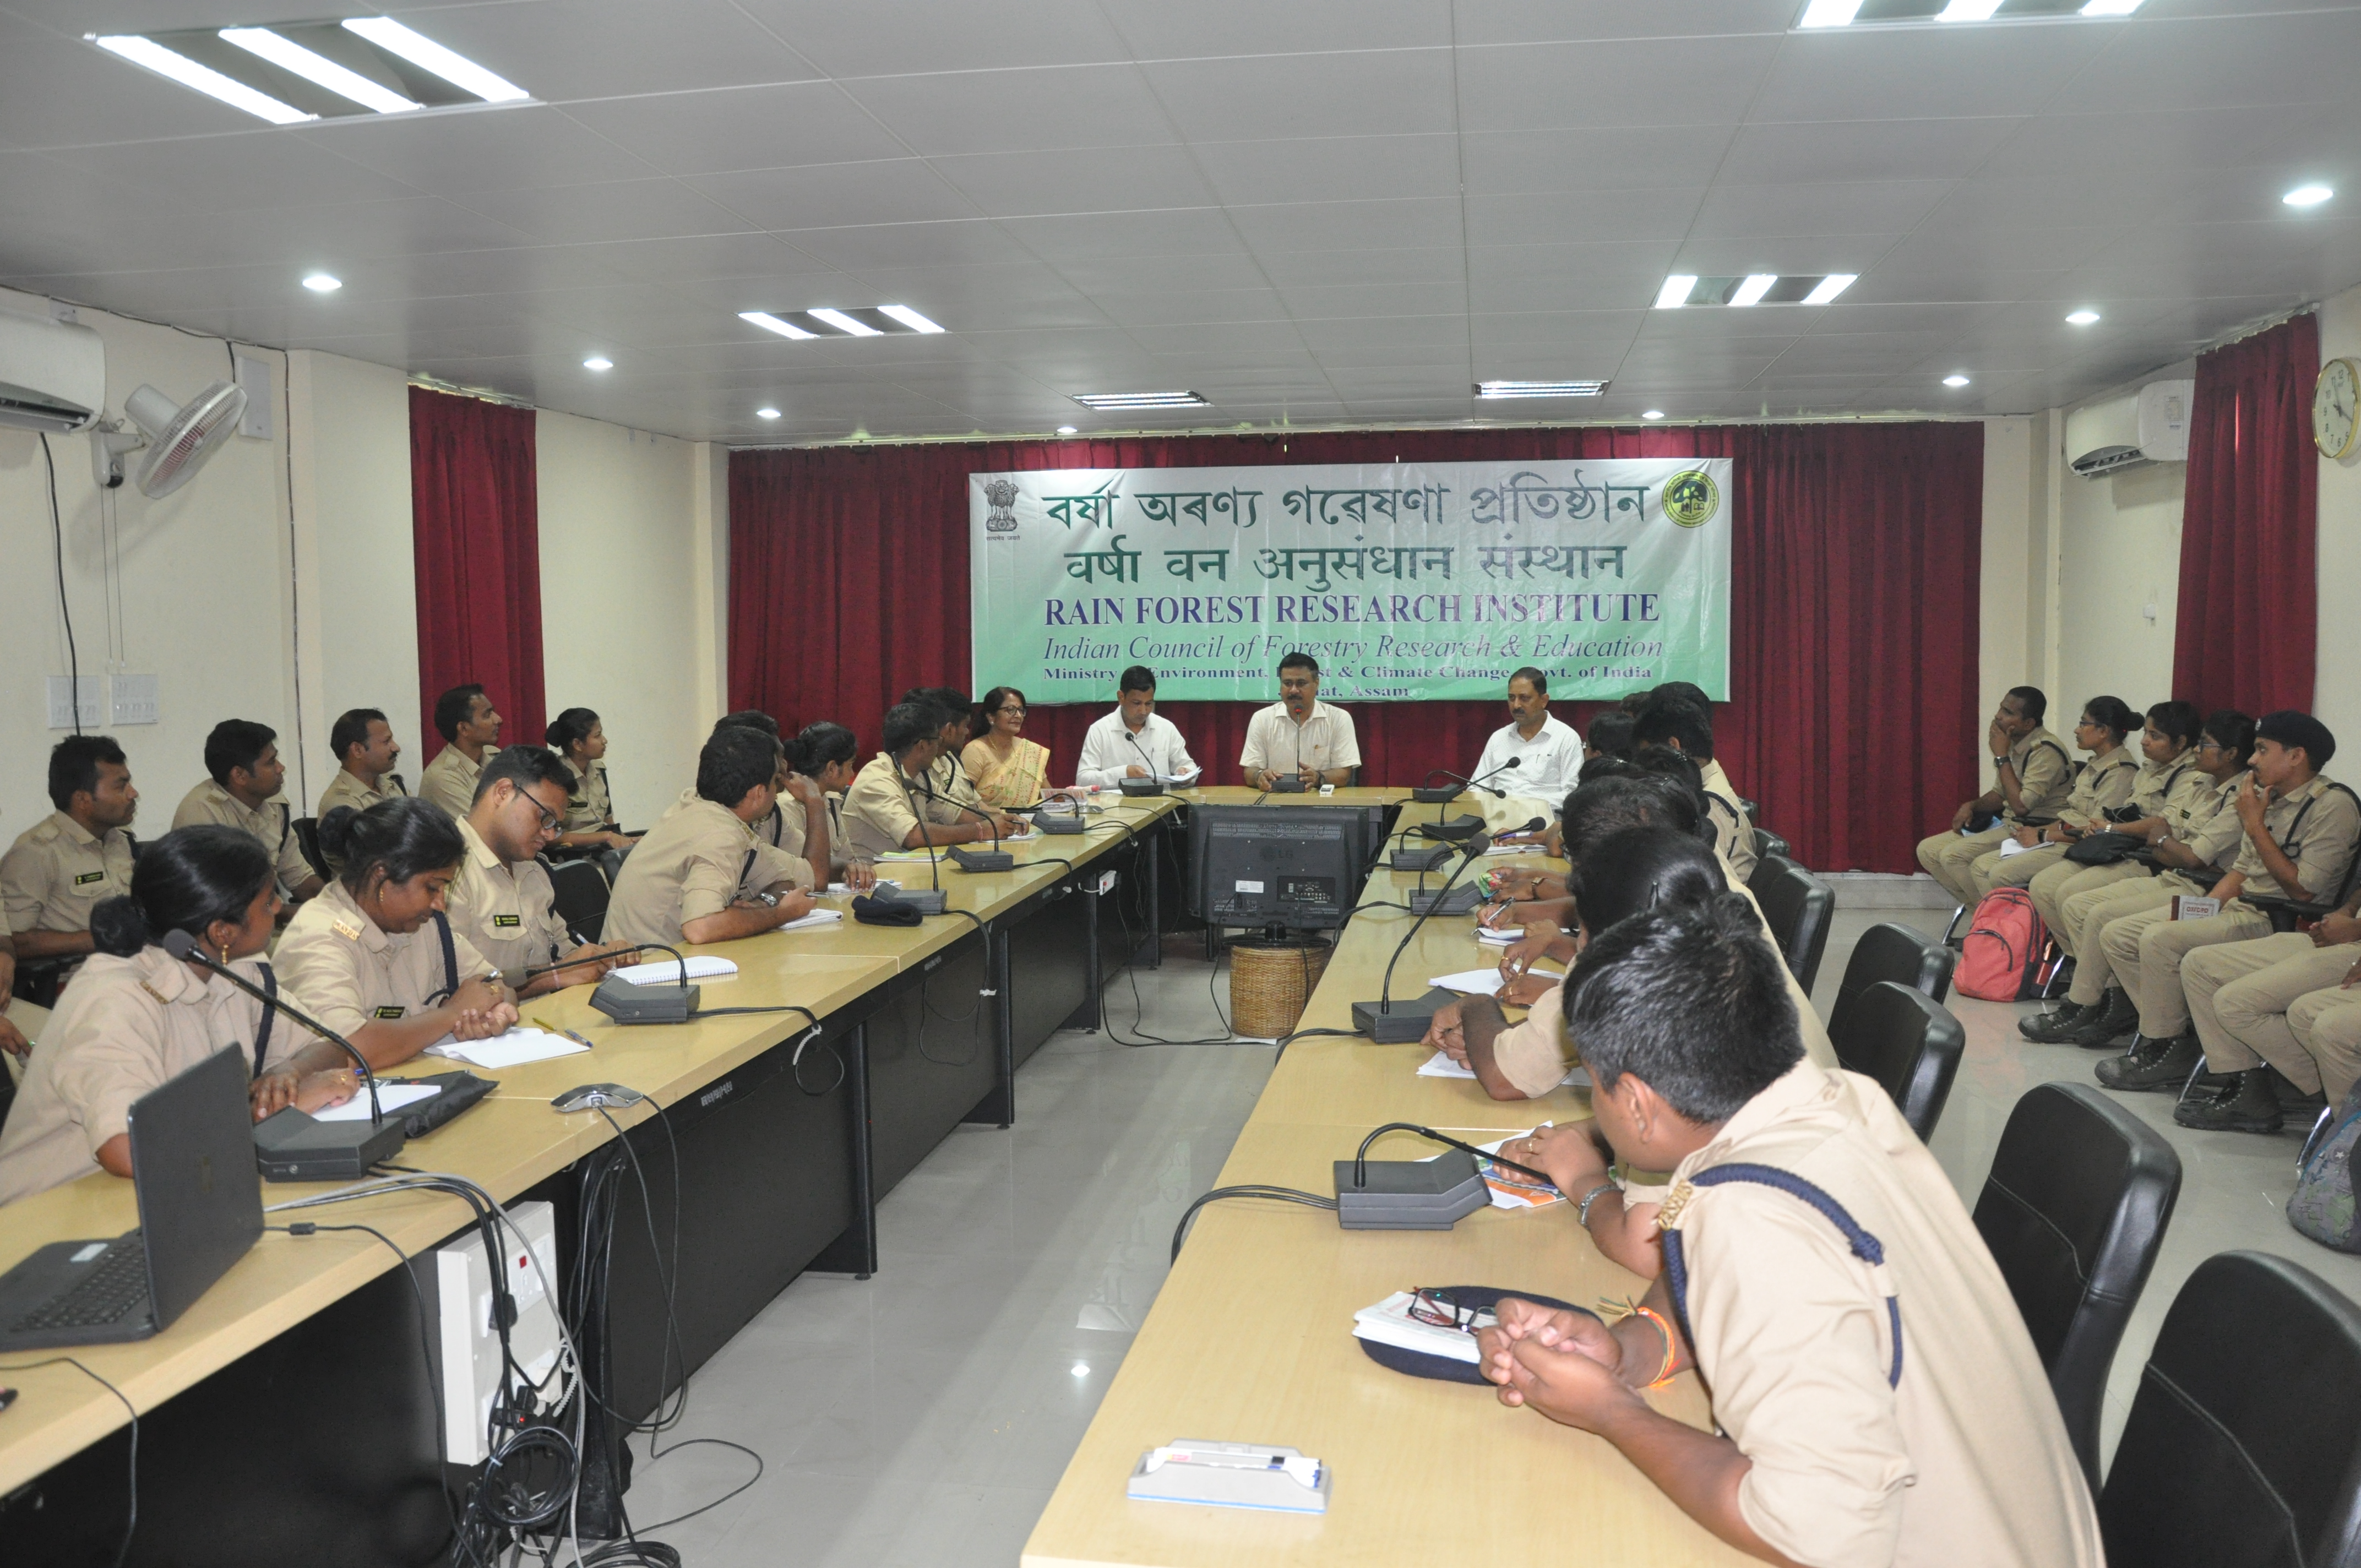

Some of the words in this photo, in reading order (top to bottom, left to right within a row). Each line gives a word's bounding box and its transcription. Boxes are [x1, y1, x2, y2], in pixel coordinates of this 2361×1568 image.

[2338, 369, 2343, 379] 12
[2324, 407, 2327, 416] 9
[2325, 423, 2329, 433] 8
[2331, 434, 2334, 444] 7
[2337, 438, 2341, 447] 6
[1064, 535, 1142, 584] वर्षा
[1164, 549, 1230, 582] वन
[1253, 534, 1454, 592] अनुसंधान
[1478, 532, 1628, 580] संस्थान
[1045, 597, 1125, 625] RAIN
[1134, 596, 1265, 624] FOREST
[1275, 594, 1462, 623] RESEARCH
[1472, 594, 1660, 622] INSTITUTE
[1043, 636, 1119, 660] Indian
[1129, 635, 1224, 658] Council
[1231, 634, 1260, 664] of
[1262, 635, 1368, 664] Forestry
[1377, 634, 1491, 657] Research
[1500, 634, 1522, 657] &
[1532, 634, 1662, 657] Education
[1044, 668, 1117, 682] Ministry
[1338, 666, 1354, 678] &
[1361, 666, 1432, 678] Climate
[1438, 666, 1513, 681] Change
[1540, 667, 1571, 678] ovt.
[1579, 666, 1598, 678] of
[1603, 666, 1651, 678] India
[1350, 686, 1408, 696] Assam
